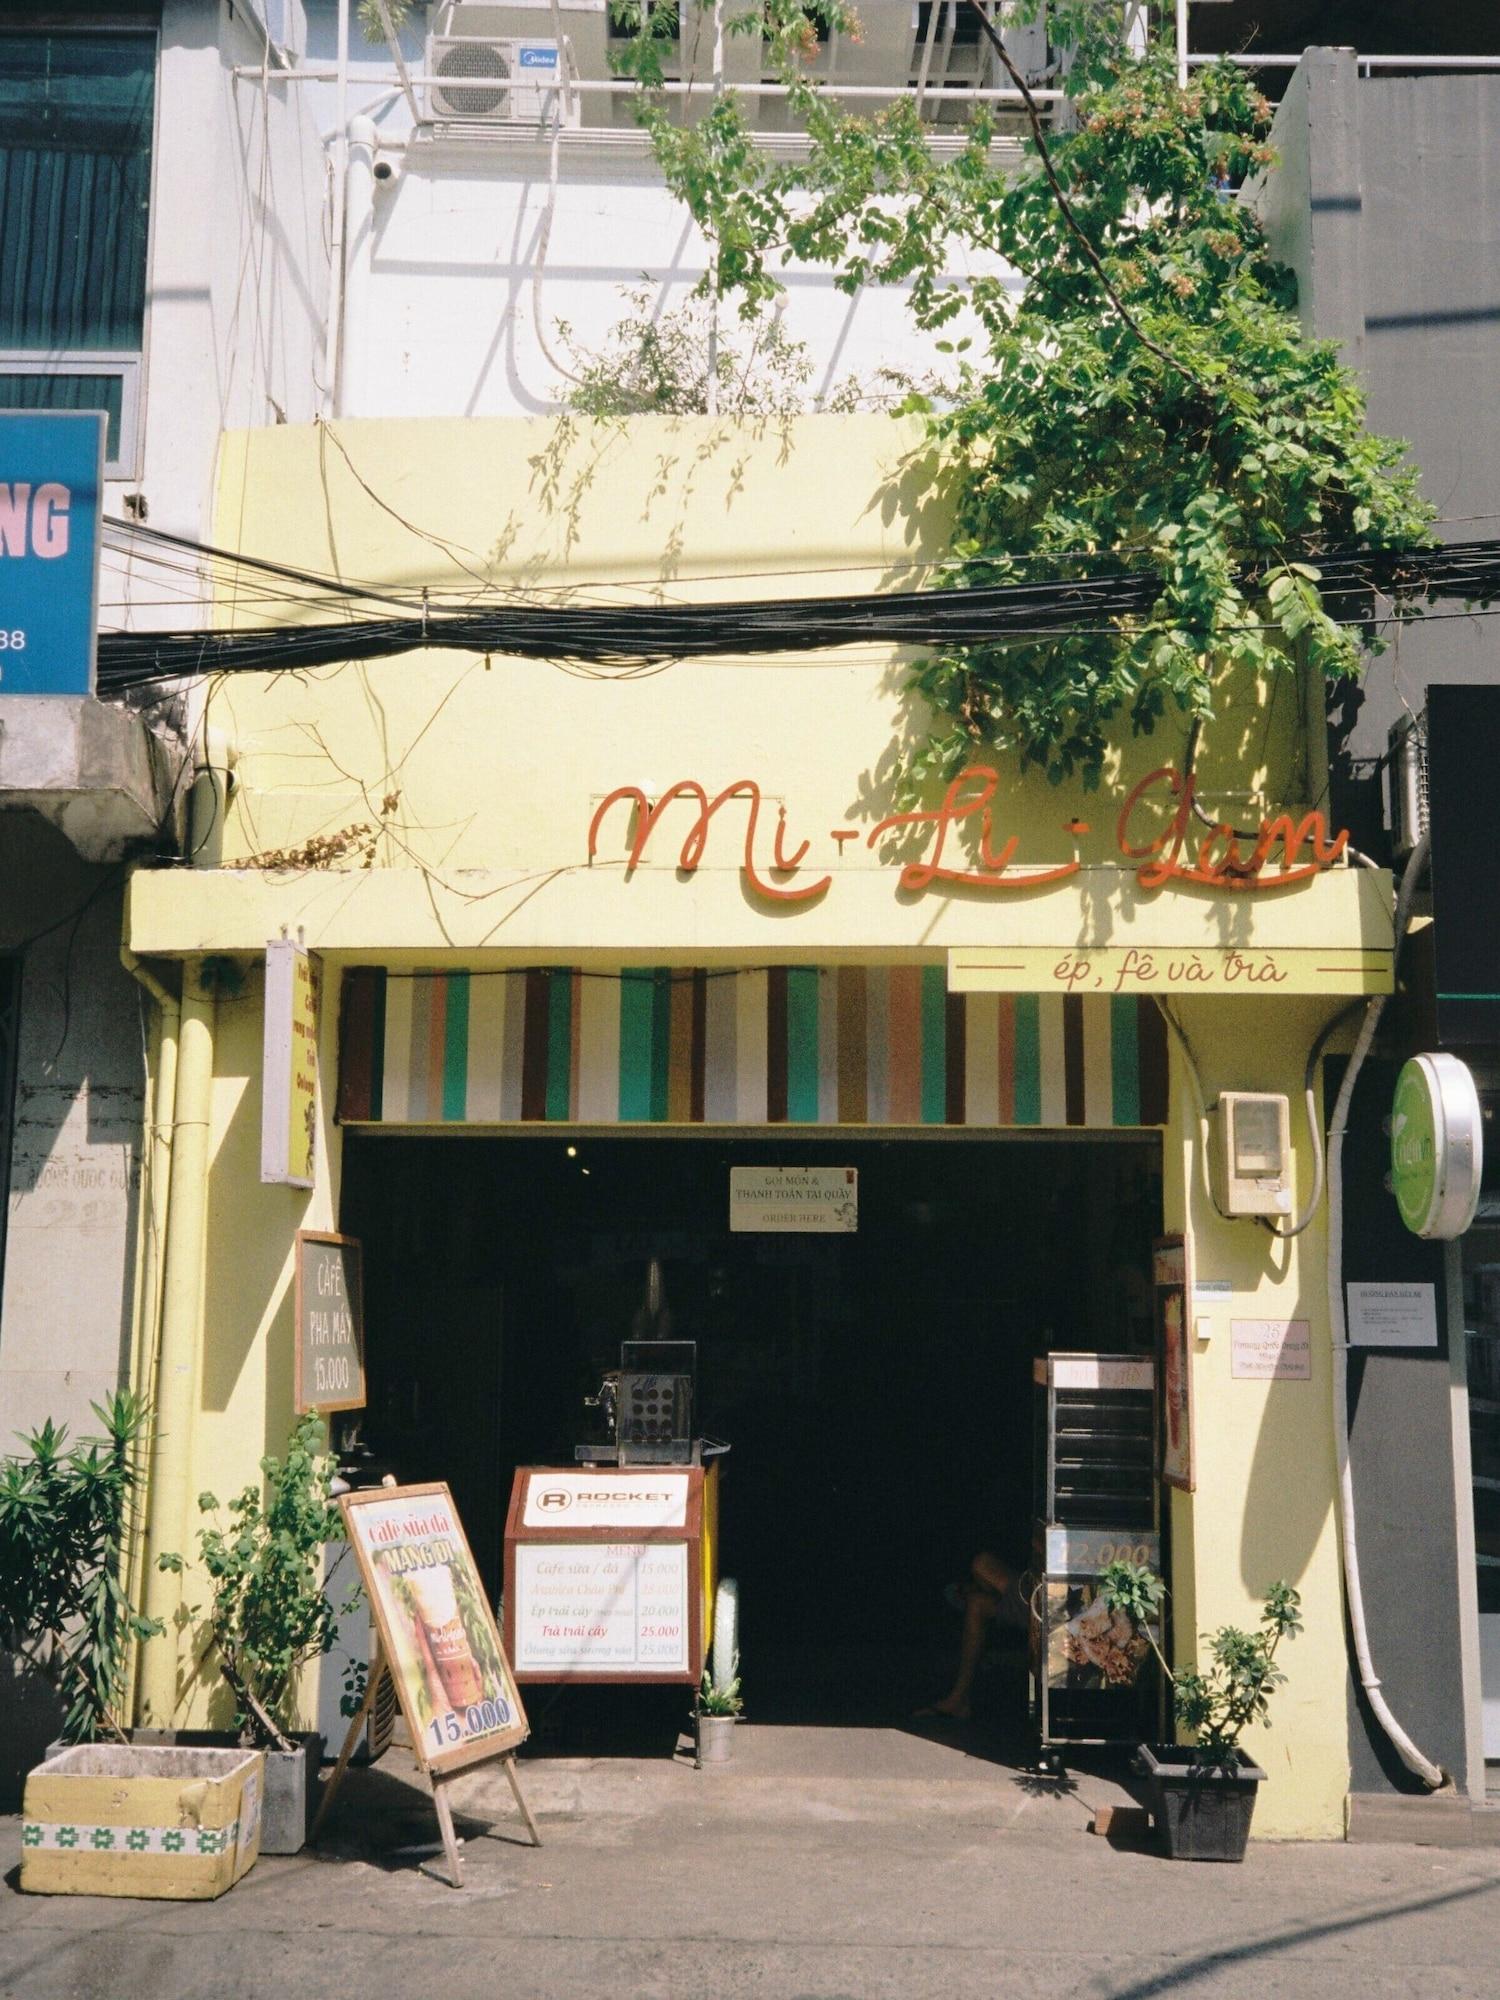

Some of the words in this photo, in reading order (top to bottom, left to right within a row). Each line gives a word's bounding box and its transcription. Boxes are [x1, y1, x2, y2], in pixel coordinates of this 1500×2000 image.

[1114, 949, 1159, 992] fê
[1168, 955, 1214, 982] và
[1224, 950, 1288, 983] trà
[735, 1188, 772, 1201] THANH
[763, 1213, 797, 1224] ORDER
[799, 1213, 827, 1224] HERE
[309, 1311, 330, 1346] PHA
[315, 1356, 350, 1392] 15.000
[576, 1492, 673, 1502] ROCKET
[383, 1544, 436, 1573] MANG
[640, 1625, 679, 1637] 25.000
[429, 1696, 511, 1747] 15.000
